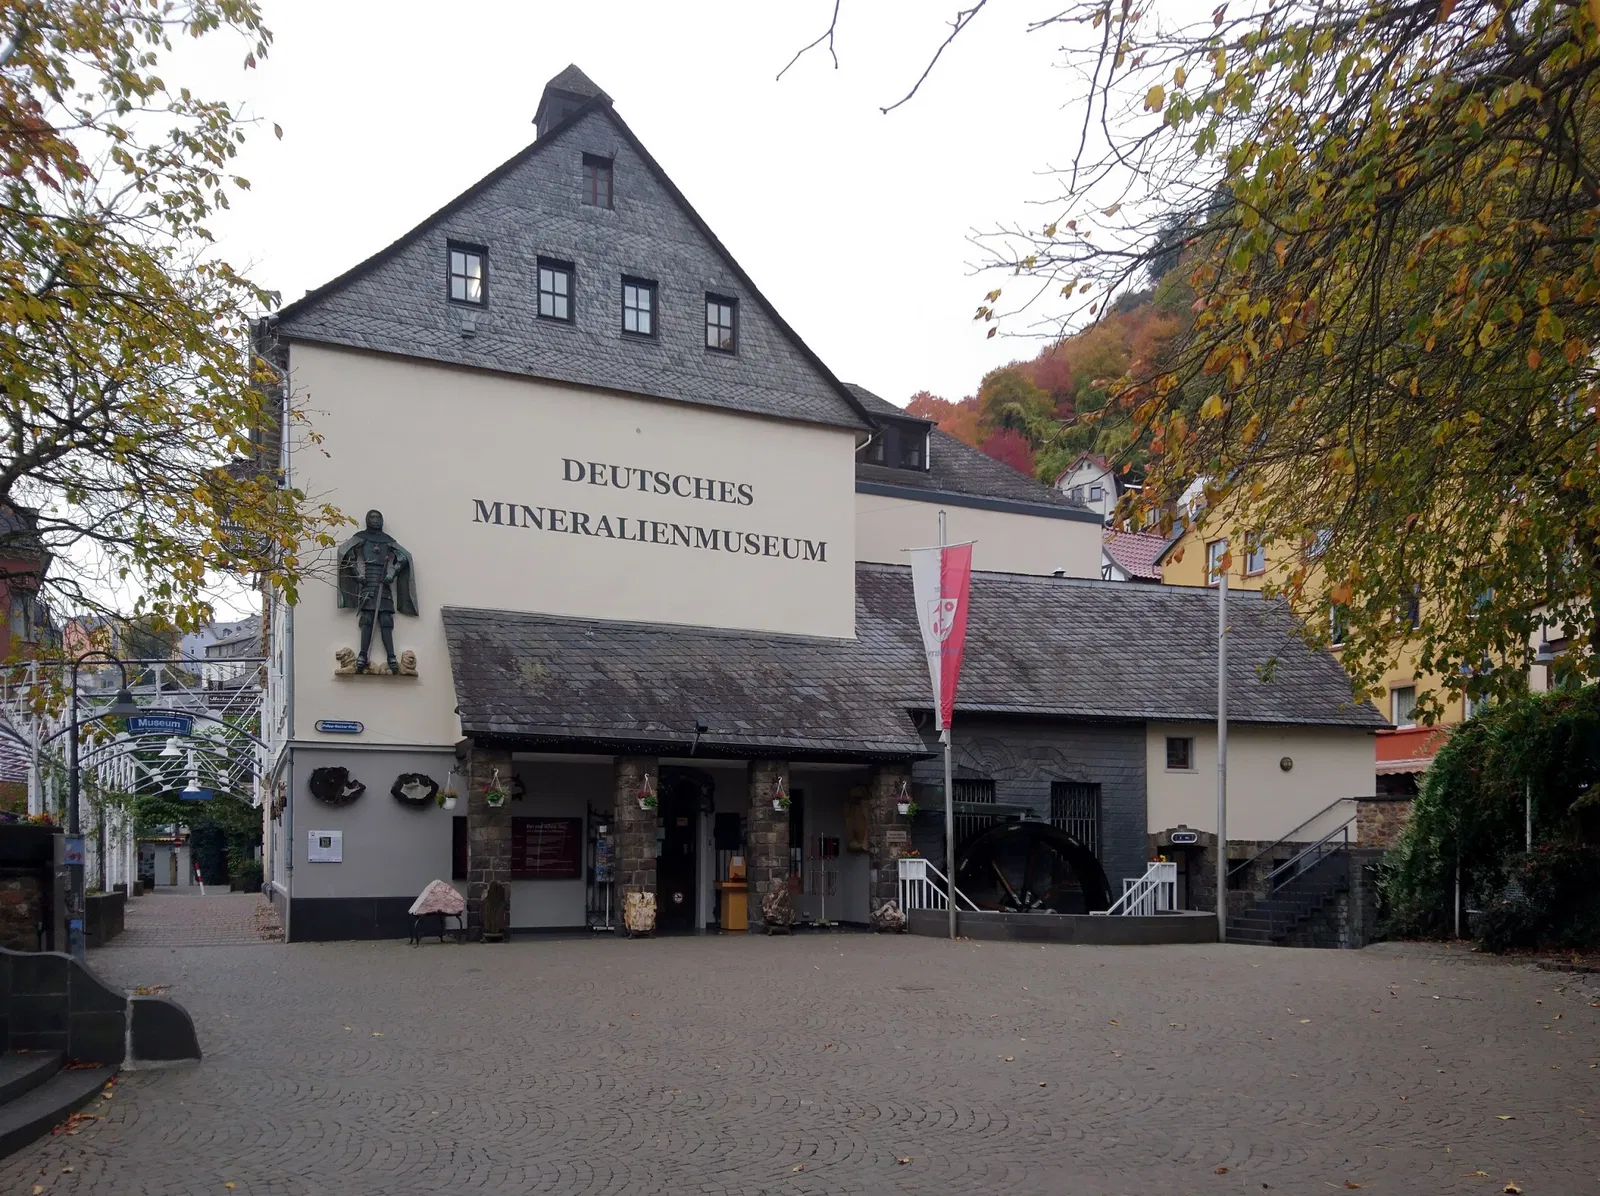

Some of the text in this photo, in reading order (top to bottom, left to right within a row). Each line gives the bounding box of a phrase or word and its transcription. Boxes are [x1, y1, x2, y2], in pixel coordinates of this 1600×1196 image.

[561, 457, 754, 506] DEUTSCHES
[472, 498, 828, 563] MINERALIENMUSEUM
[138, 718, 180, 728] Museum
